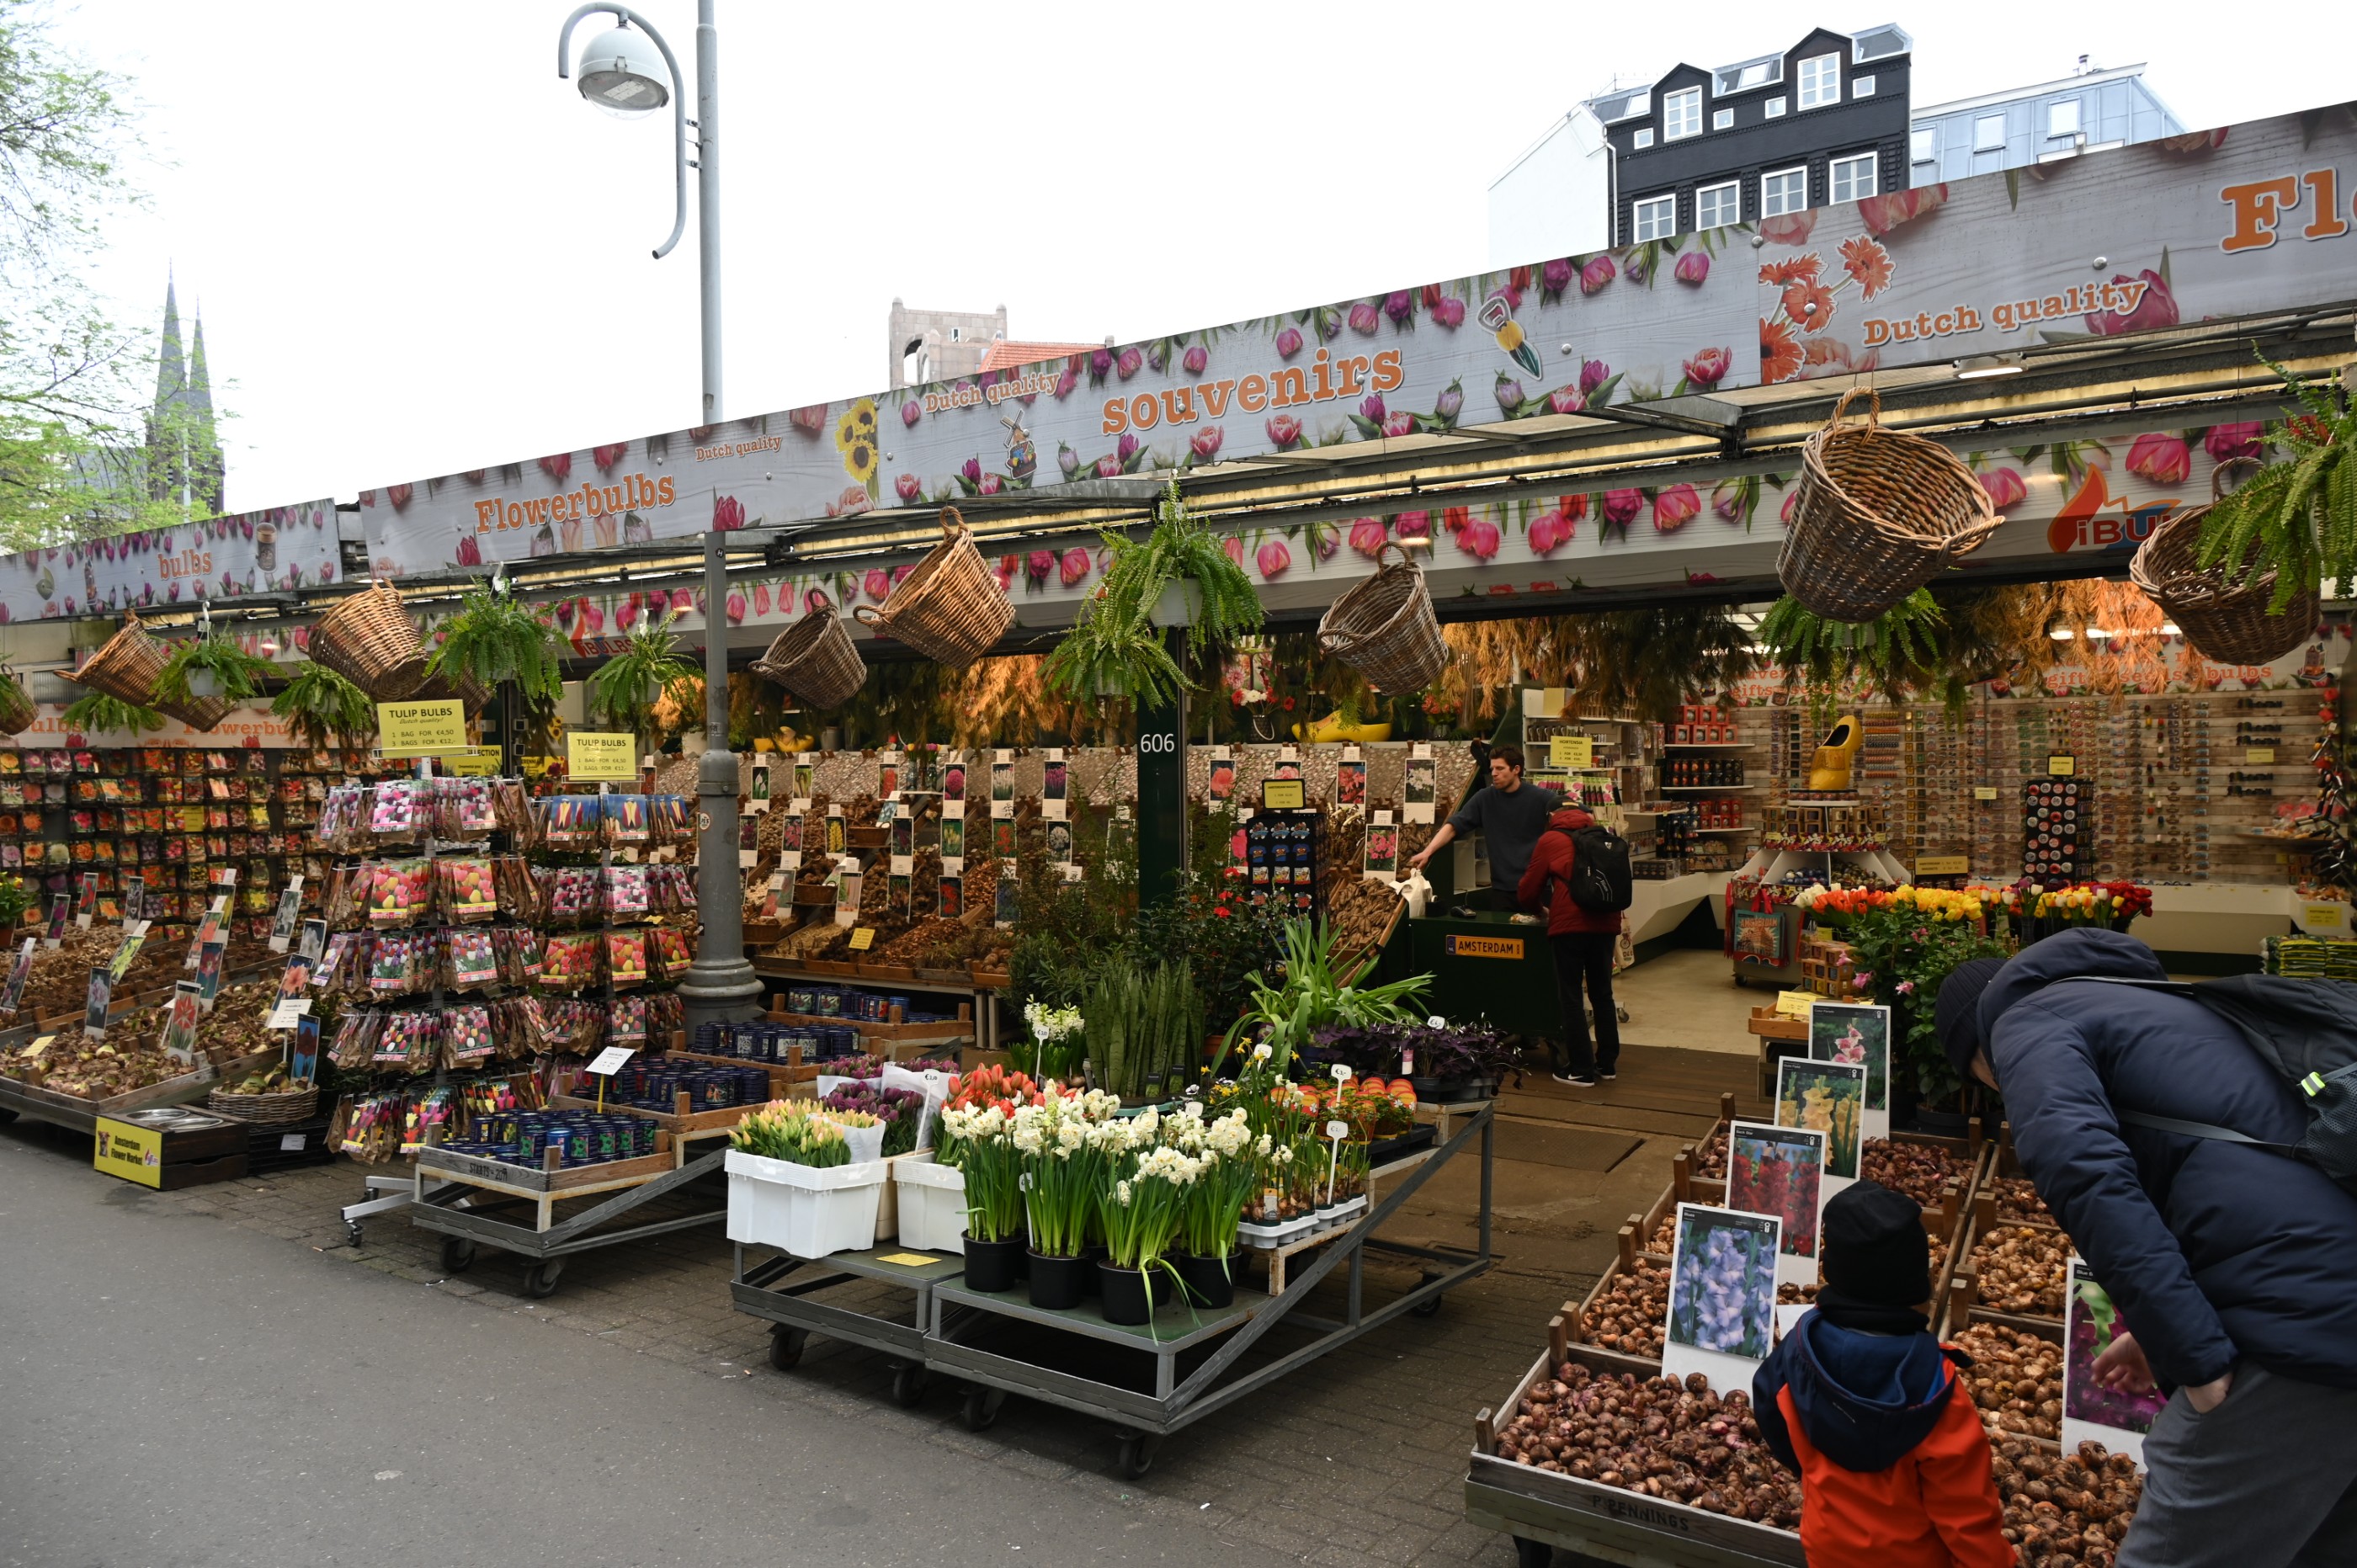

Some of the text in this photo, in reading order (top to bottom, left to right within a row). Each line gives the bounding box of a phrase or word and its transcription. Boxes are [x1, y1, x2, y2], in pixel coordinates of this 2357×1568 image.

[2219, 168, 2357, 253] Fl
[1864, 280, 2150, 347] Dutch quality
[925, 371, 1061, 413] Dutch quality
[1101, 348, 1404, 435] souvenirs
[695, 434, 782, 462] Dutch quality
[475, 473, 676, 534] Flowerbulbs
[2077, 514, 2171, 546] iBU
[158, 548, 213, 581] bulbs
[2206, 665, 2273, 680] bulbs
[389, 708, 453, 719] TULIP BULBS
[1141, 733, 1174, 752] 606
[1740, 917, 1778, 928] AMSTERDAM
[1458, 941, 1514, 954] AMSTERDAM
[110, 1147, 126, 1161] Flower
[126, 1151, 143, 1167] Market
[114, 1135, 141, 1151] Amsterdam
[1607, 1498, 1689, 1531] PENNINGS
